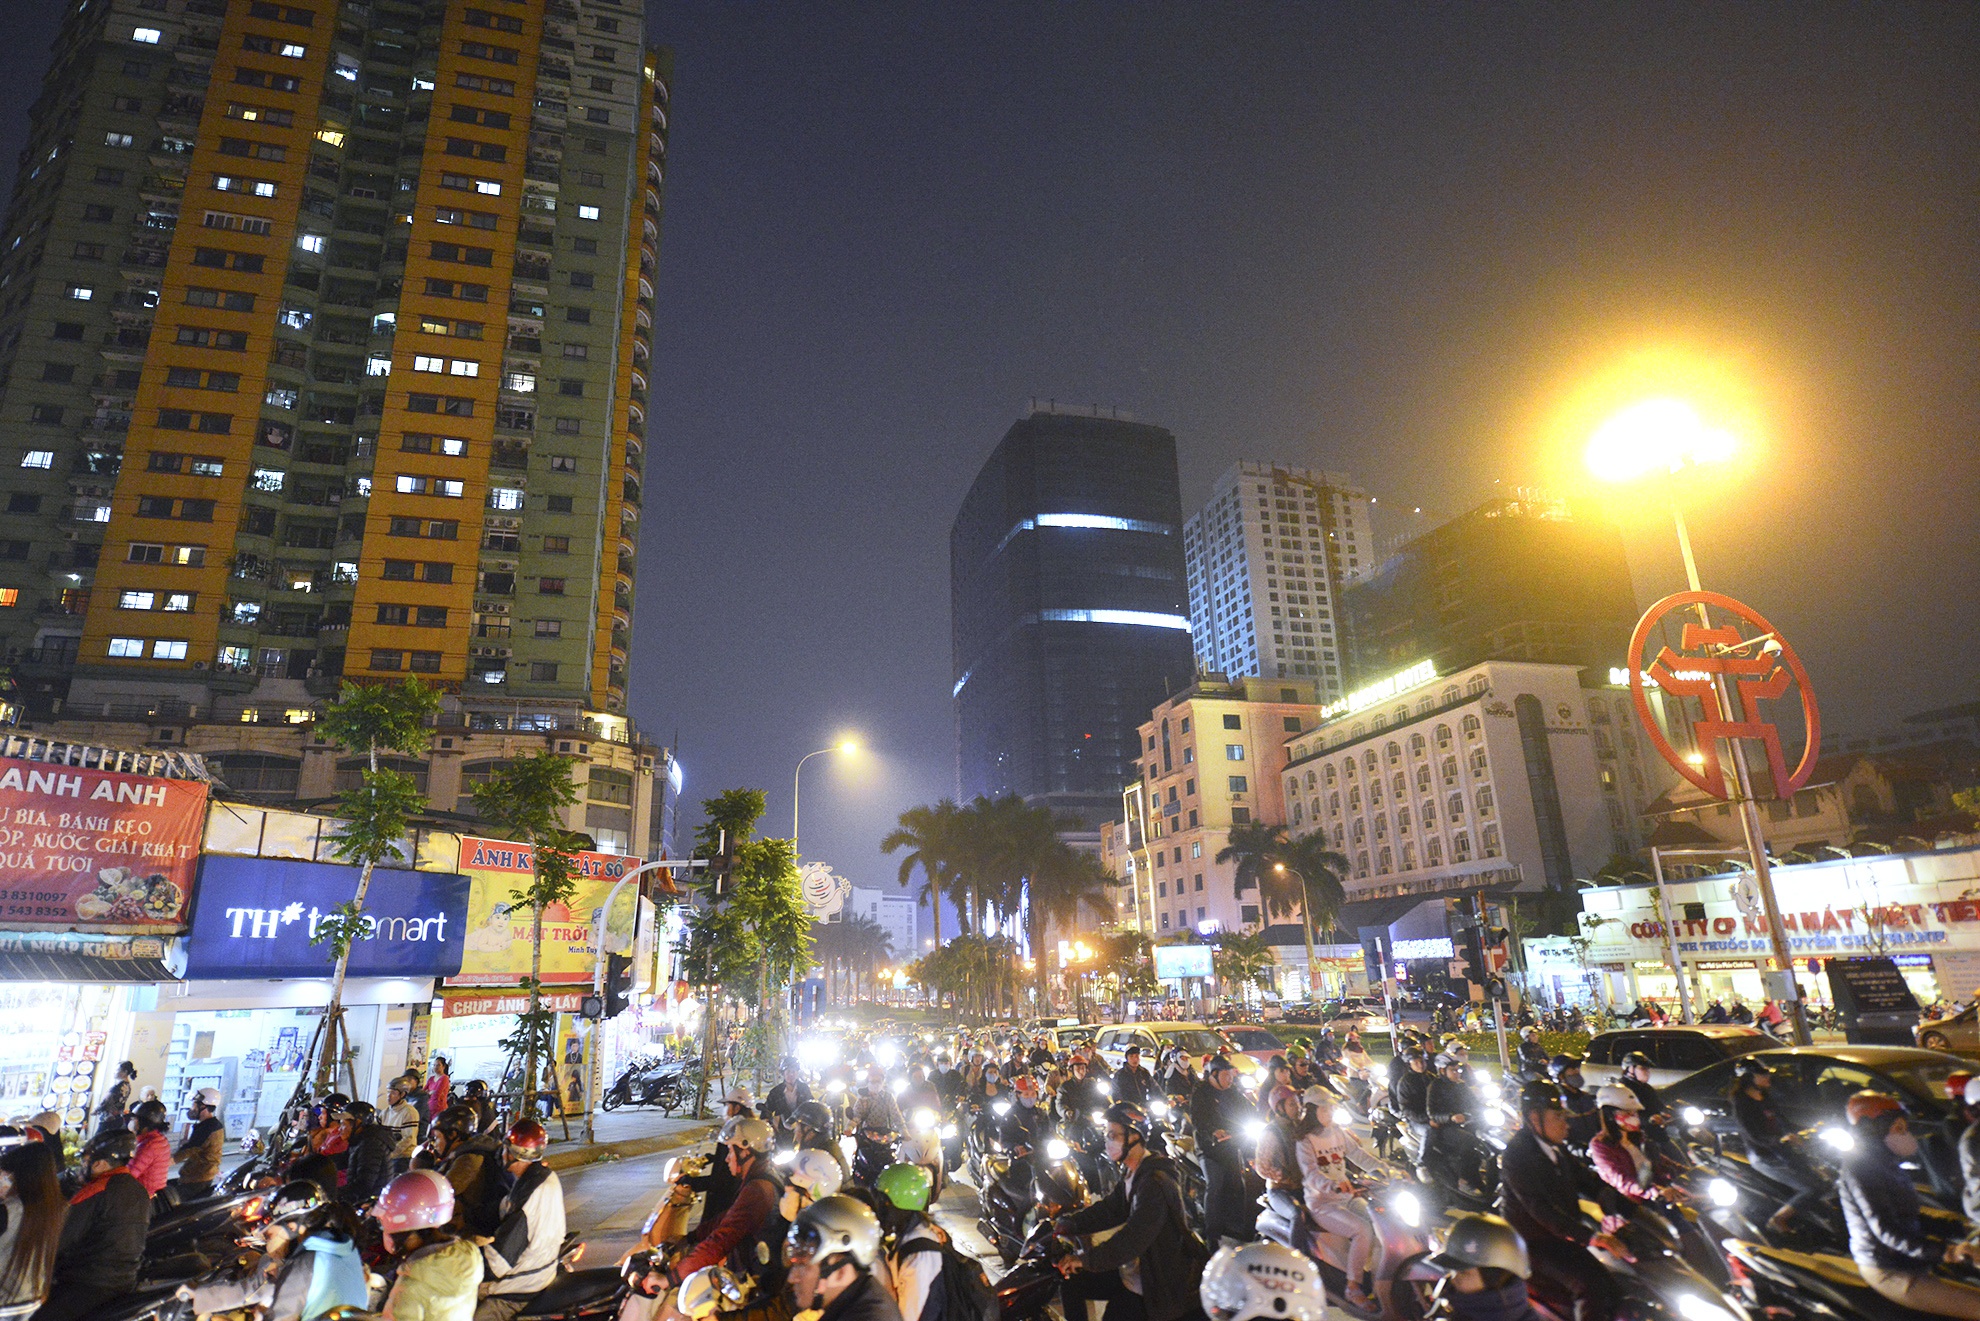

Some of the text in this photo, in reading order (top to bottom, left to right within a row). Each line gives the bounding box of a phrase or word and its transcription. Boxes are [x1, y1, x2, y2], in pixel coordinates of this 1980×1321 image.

[1394, 659, 1437, 693] HOTEL
[0, 767, 167, 807] ANH ANH
[58, 811, 110, 832] BÁNH
[112, 818, 152, 836] KẸO
[32, 832, 91, 852] NƯỚC
[95, 836, 138, 855] GIẢI
[141, 841, 192, 859] KHÁT
[44, 854, 94, 874] TƯƠI
[471, 841, 513, 869] ẢNH
[516, 852, 536, 870] K
[604, 856, 627, 878] SỐ
[11, 890, 68, 902] 8310097
[7, 905, 33, 915] 543
[35, 906, 67, 917] 8352
[226, 907, 281, 939] TH
[1683, 918, 1709, 937] TY
[1713, 917, 1737, 935] CP
[552, 925, 589, 942] TRỜI
[1701, 936, 1749, 951] THUỐC
[1247, 1264, 1305, 1282] HINO
